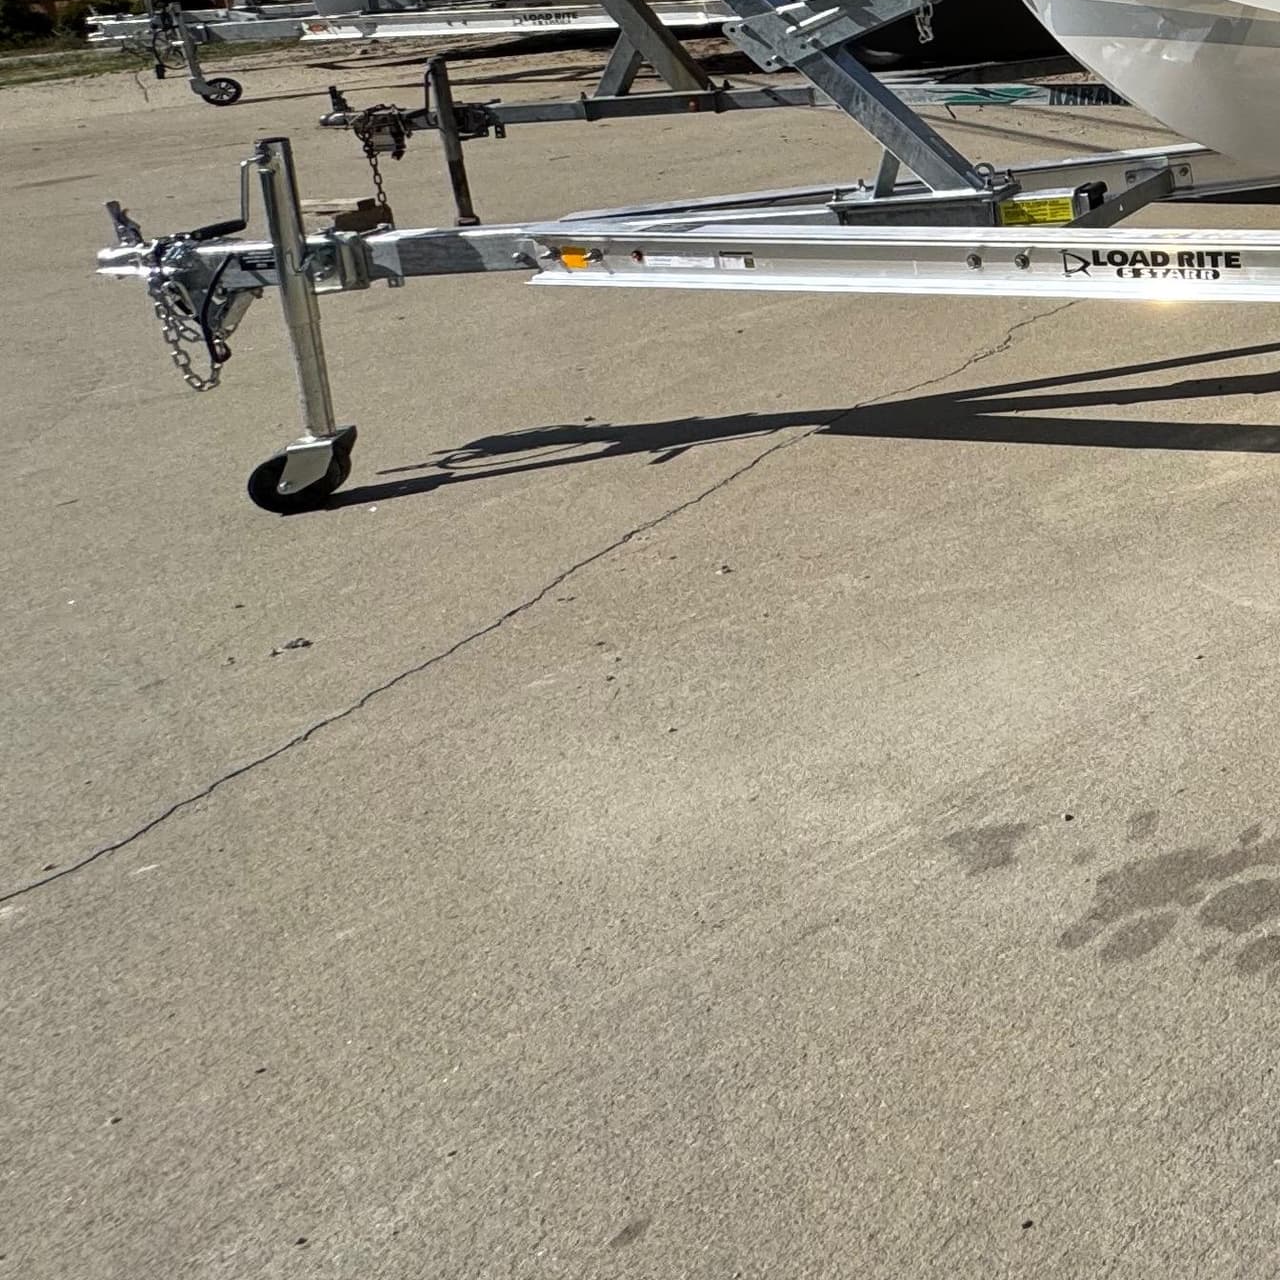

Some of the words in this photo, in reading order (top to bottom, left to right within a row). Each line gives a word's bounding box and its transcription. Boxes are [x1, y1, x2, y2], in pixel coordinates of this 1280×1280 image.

[1091, 250, 1170, 268] LOAD
[1177, 251, 1242, 269] RITE
[1140, 268, 1216, 281] STARR
